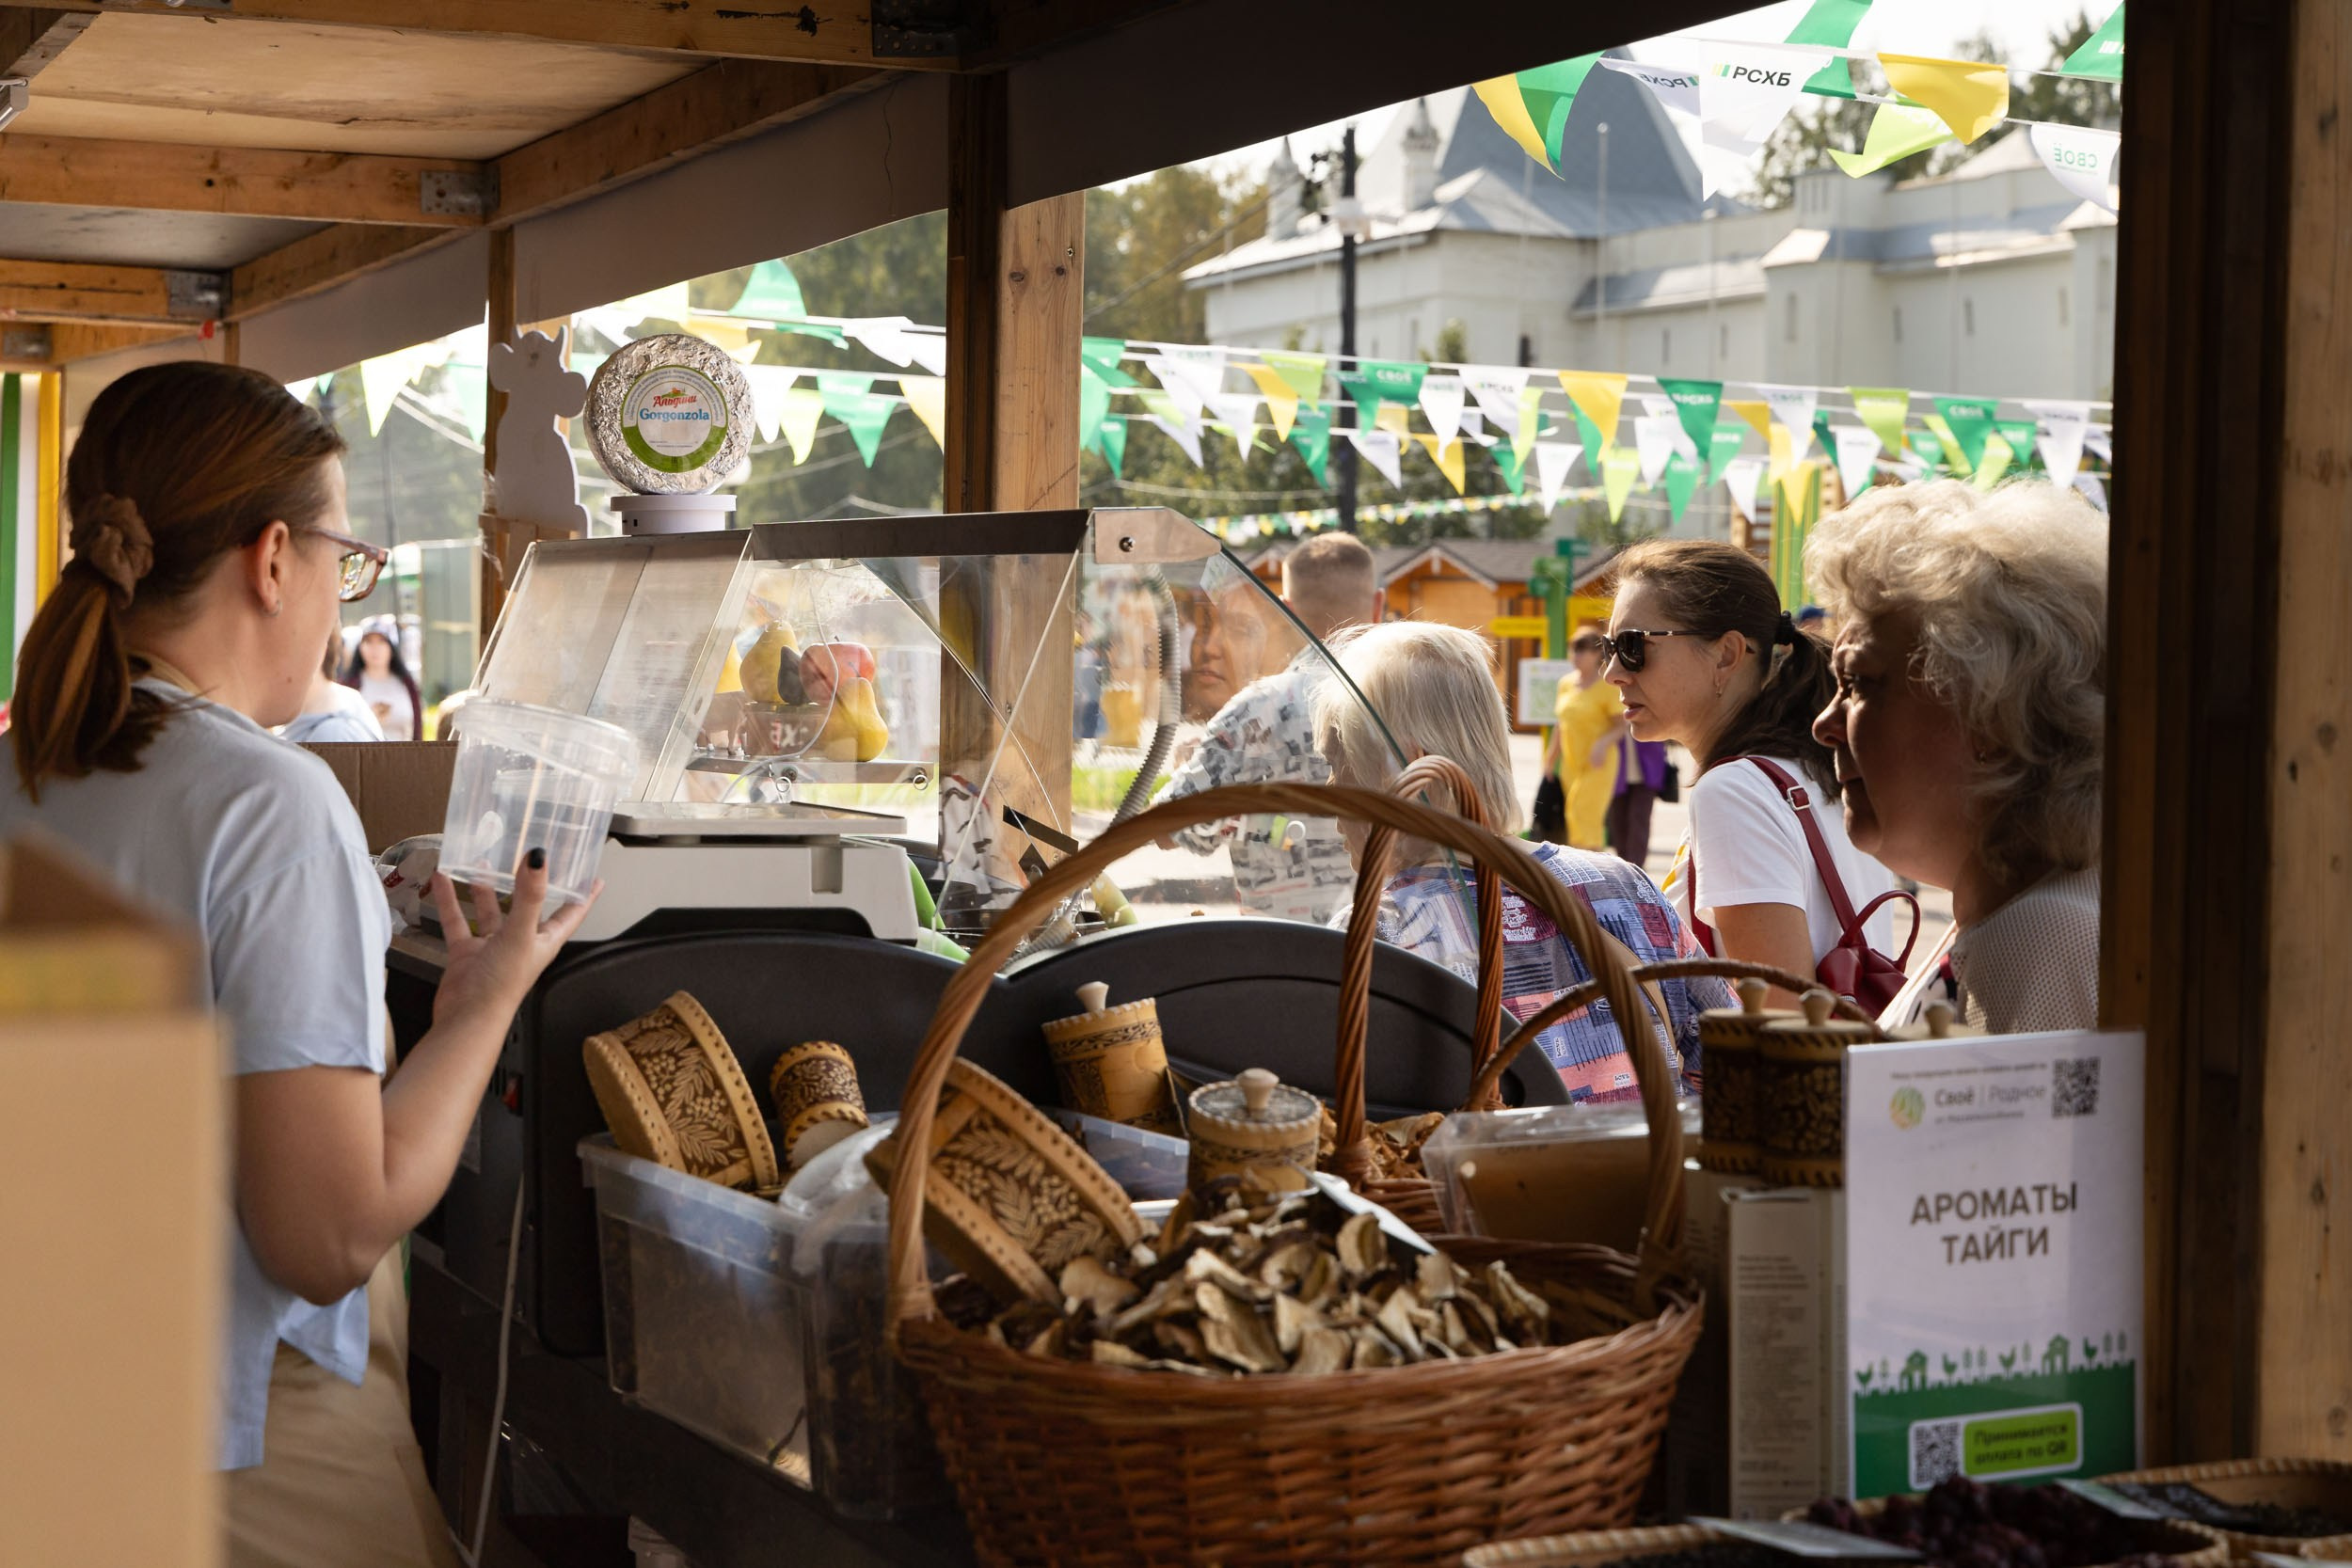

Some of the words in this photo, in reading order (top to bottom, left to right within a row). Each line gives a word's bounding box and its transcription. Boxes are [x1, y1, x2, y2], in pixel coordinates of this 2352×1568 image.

[1732, 66, 1791, 87] РСХБ
[640, 408, 709, 421] Gorgonzola
[1934, 1085, 1974, 1107] Своё
[1910, 1181, 2077, 1226] АРОМАТЫ
[1941, 1225, 2049, 1264] ТАЙГИ
